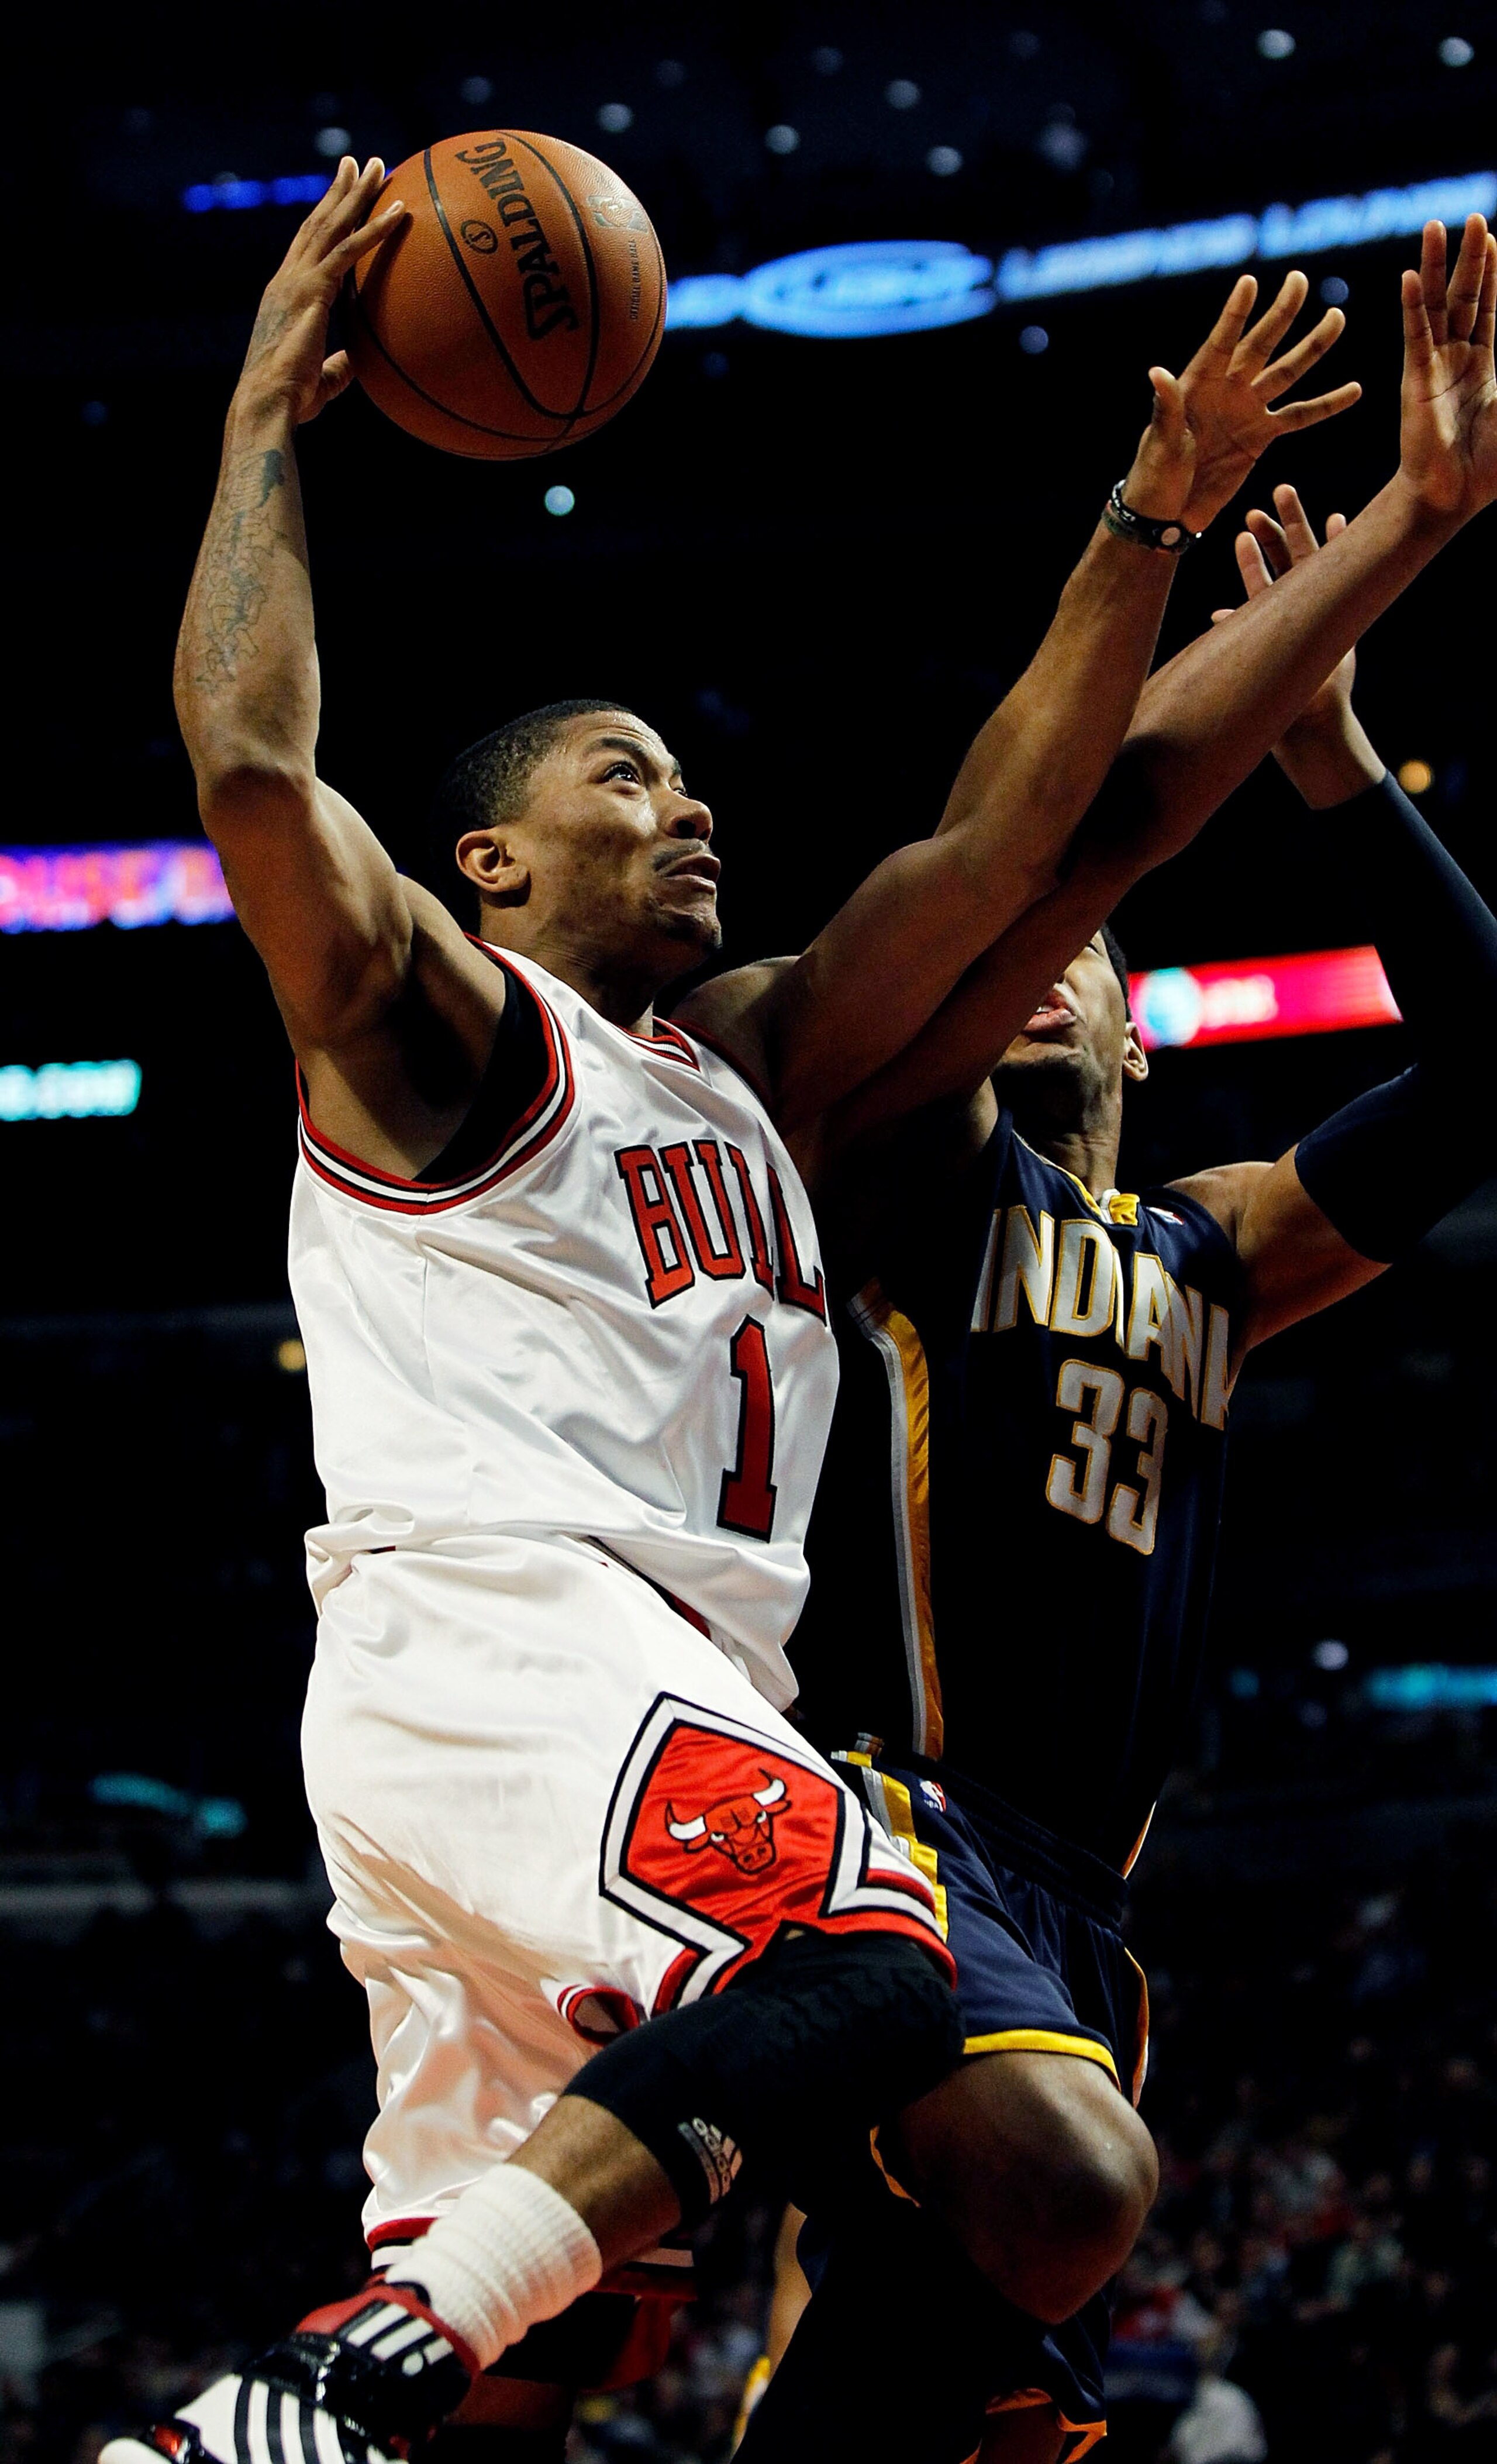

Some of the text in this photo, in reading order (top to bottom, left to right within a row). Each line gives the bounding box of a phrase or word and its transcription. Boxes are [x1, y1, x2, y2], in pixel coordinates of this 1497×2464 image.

[455, 140, 578, 340] SPALDING
[716, 1314, 777, 1543] 1
[1045, 1359, 1168, 1556] 33
